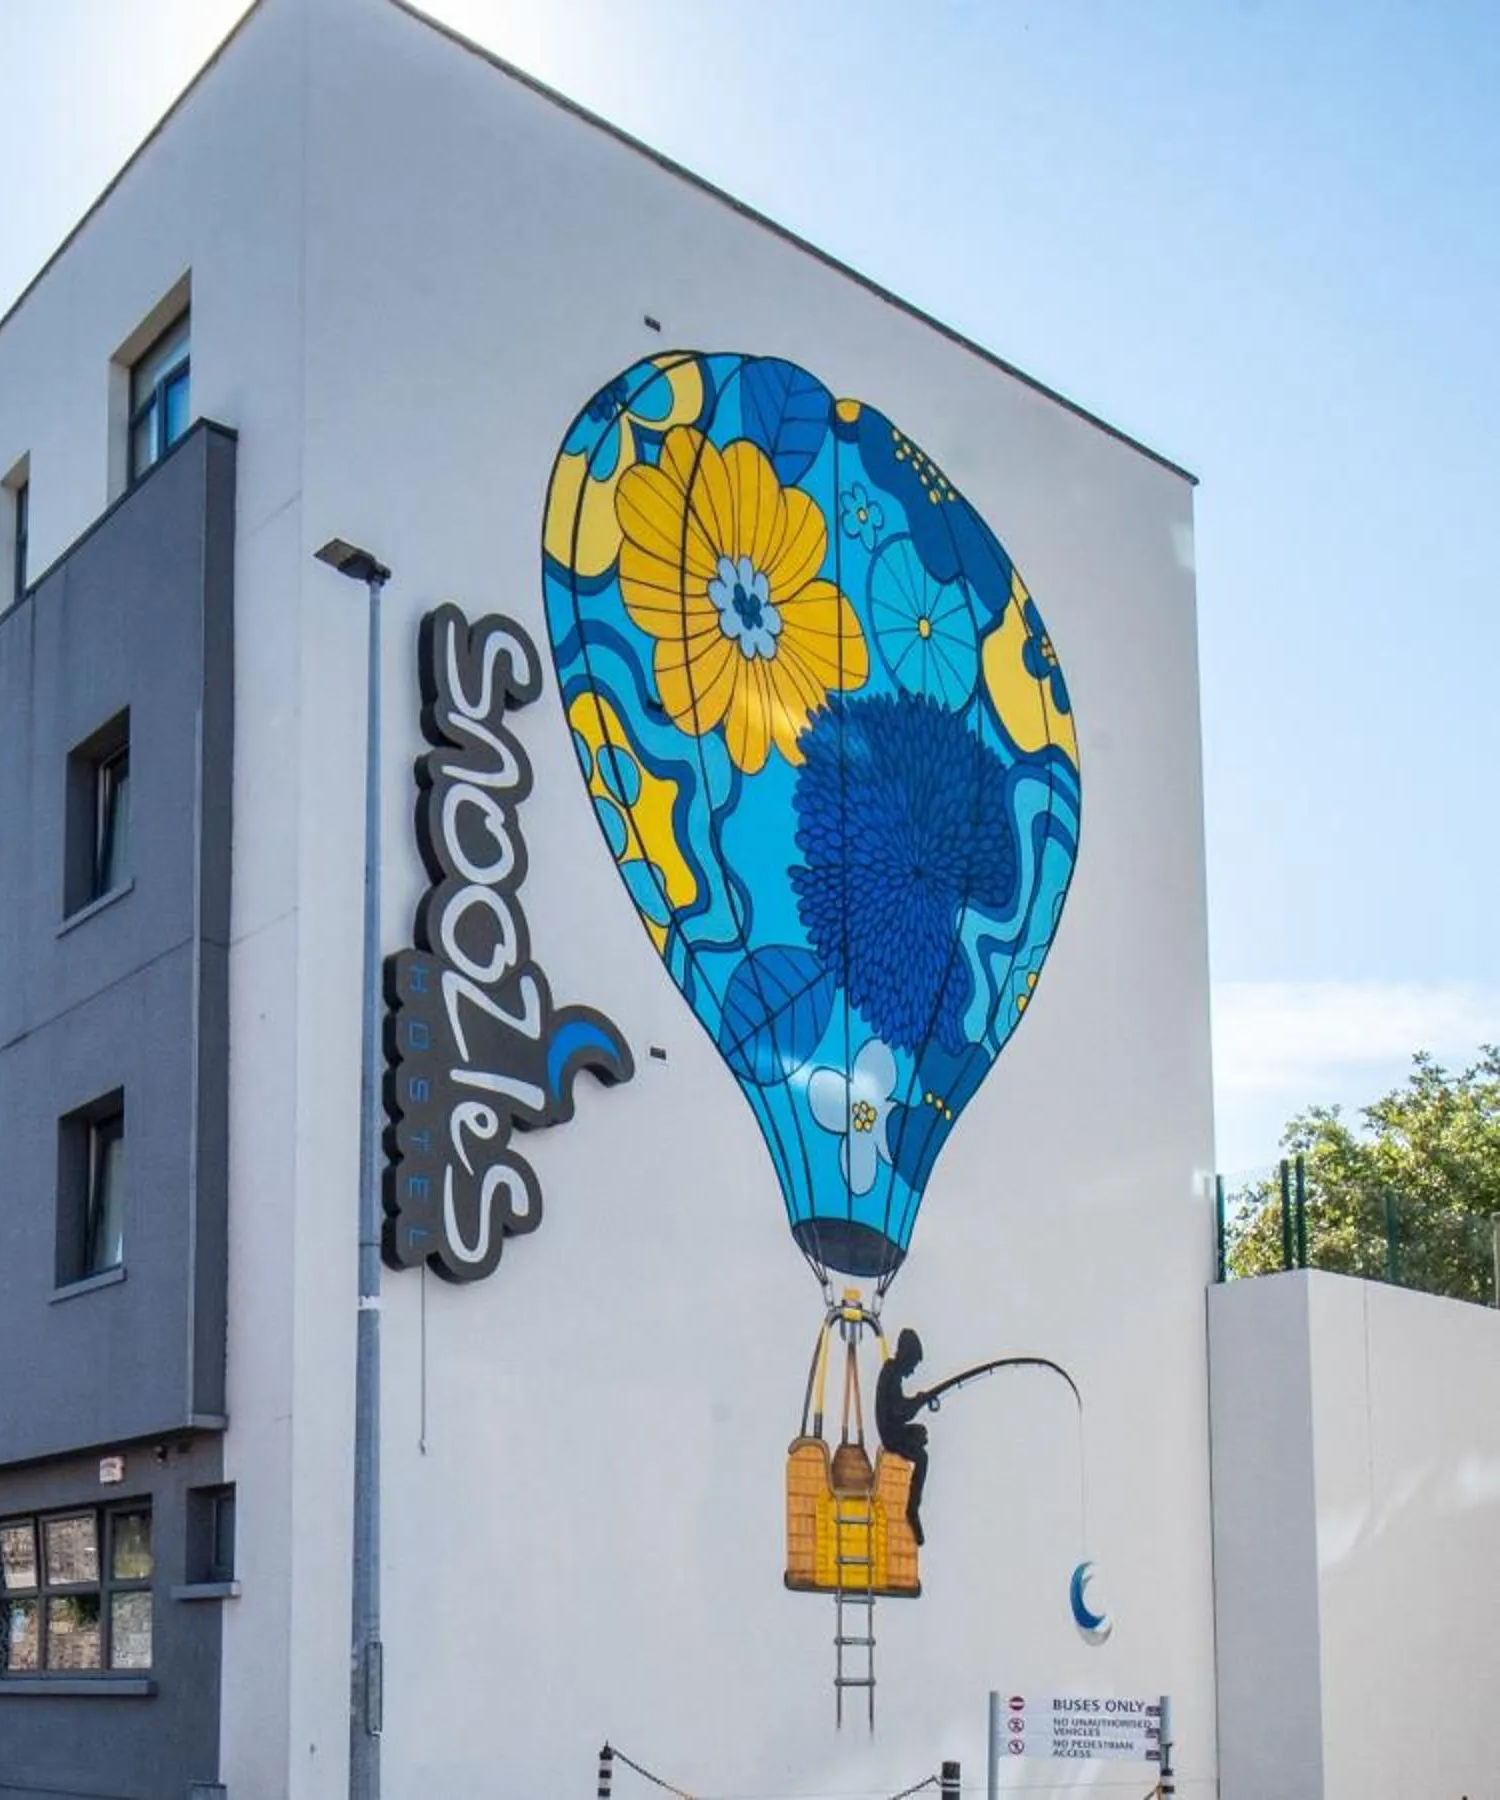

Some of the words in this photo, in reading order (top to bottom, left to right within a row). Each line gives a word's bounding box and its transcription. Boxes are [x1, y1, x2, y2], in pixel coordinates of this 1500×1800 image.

[409, 965, 429, 1247] HOSTEL
[1053, 1699, 1100, 1712] BUSES
[1105, 1700, 1144, 1712] ONLY
[1053, 1717, 1069, 1726] NO
[1053, 1727, 1101, 1737] VEHICLES
[1053, 1740, 1068, 1748] NO
[1071, 1740, 1133, 1749] PEDESTRIAN
[1052, 1749, 1092, 1758] ACCESS
